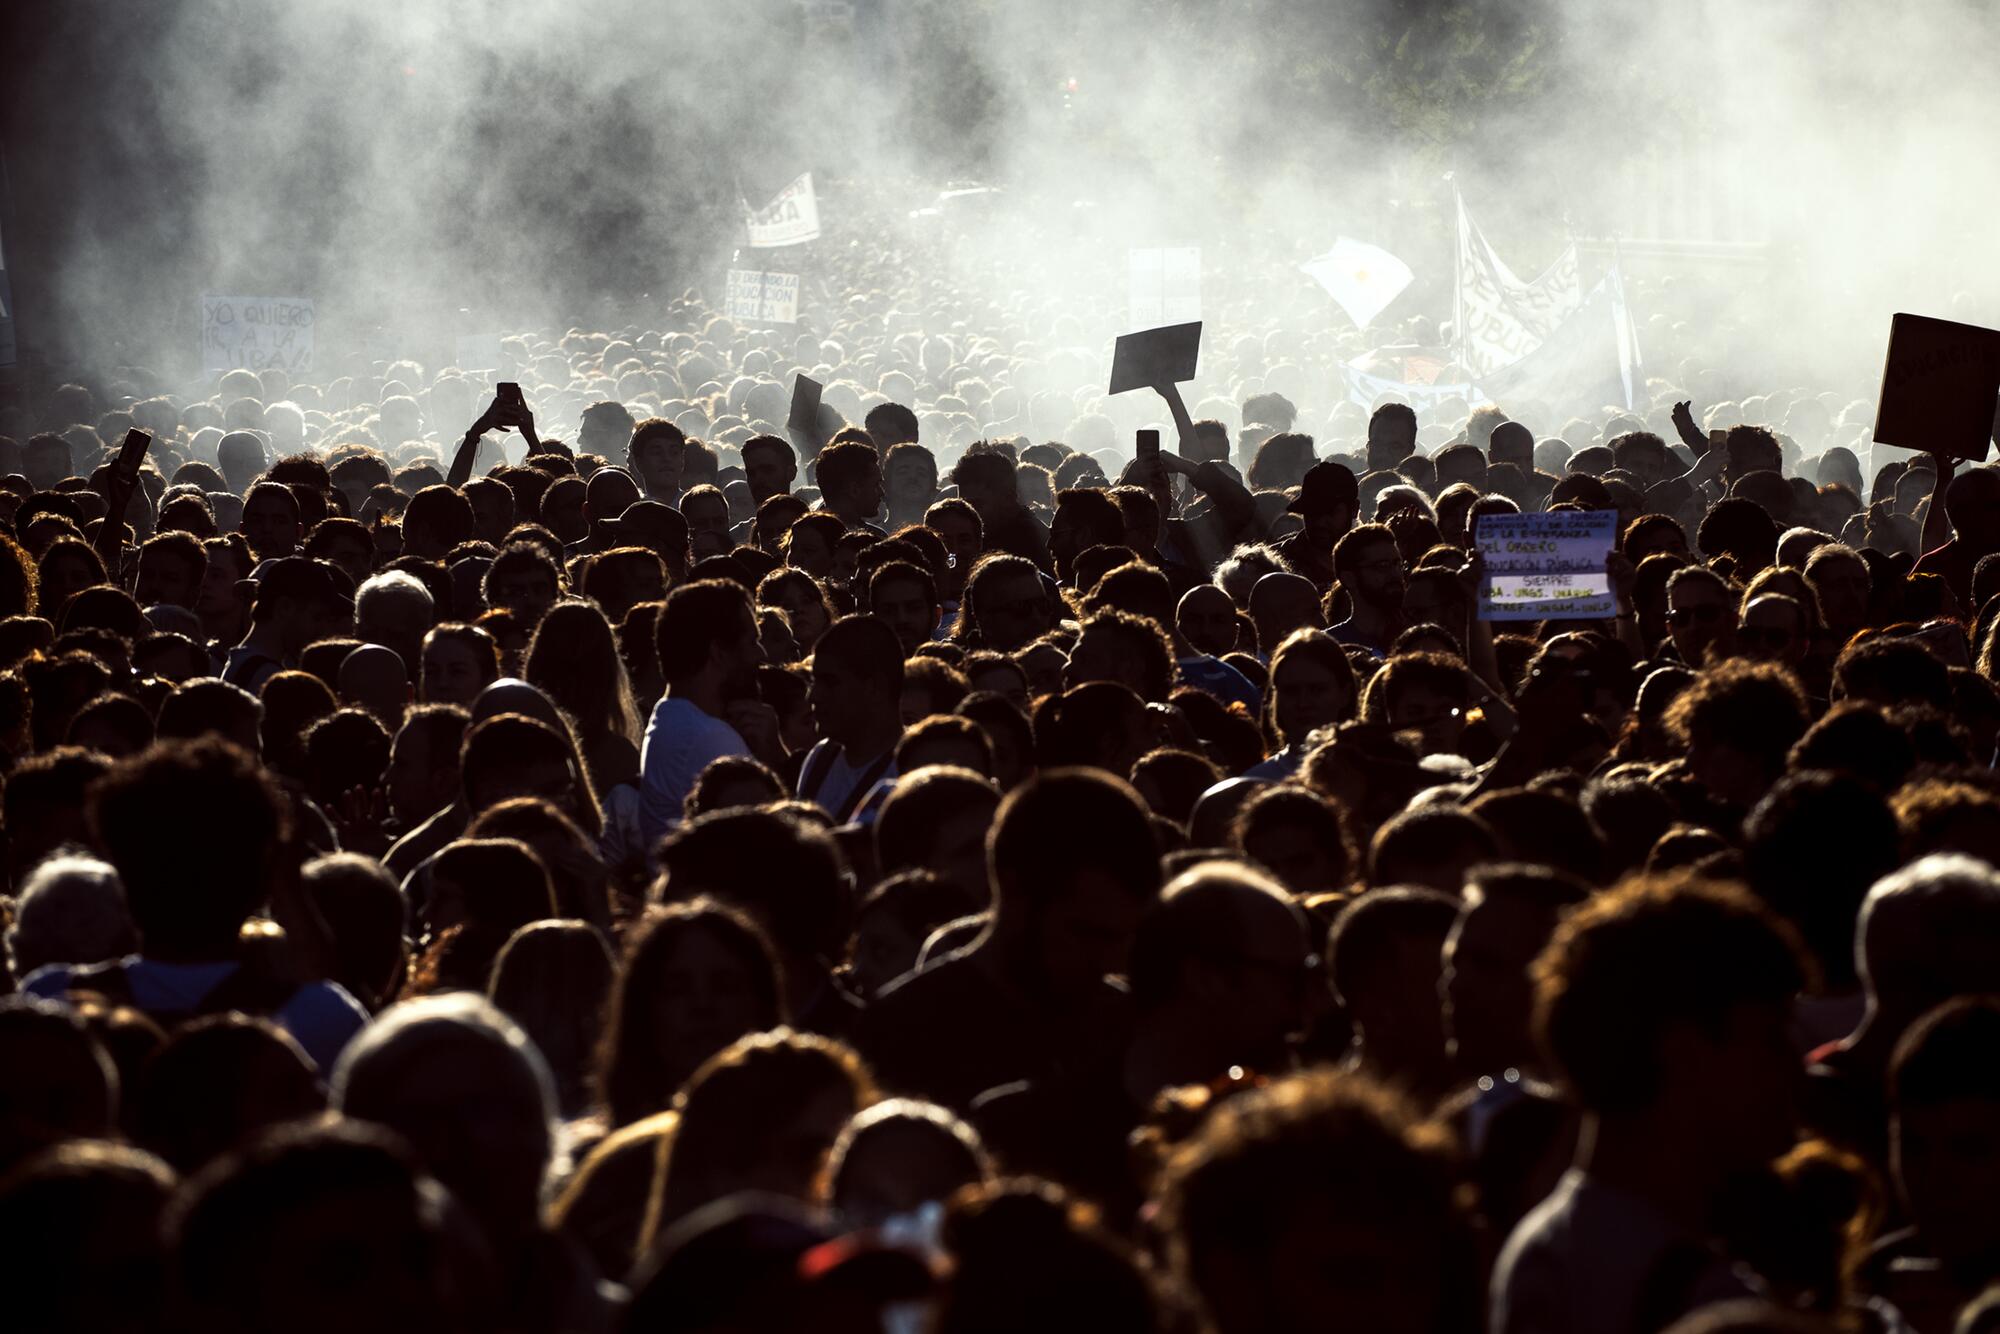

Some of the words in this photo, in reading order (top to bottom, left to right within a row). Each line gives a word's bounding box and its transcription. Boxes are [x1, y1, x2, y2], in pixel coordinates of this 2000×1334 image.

[204, 302, 235, 325] YO
[244, 303, 314, 328] QUIERO
[205, 326, 226, 350] IR
[241, 326, 258, 348] A
[273, 329, 296, 349] LA
[1479, 530, 1494, 539] ES
[1501, 530, 1514, 539] LA
[1520, 529, 1591, 539] ESPERANZA
[1478, 543, 1501, 554] DEL
[1546, 555, 1595, 572] PÚBLICA
[1522, 574, 1573, 586] SIEMPRE
[1480, 586, 1503, 598] UBA
